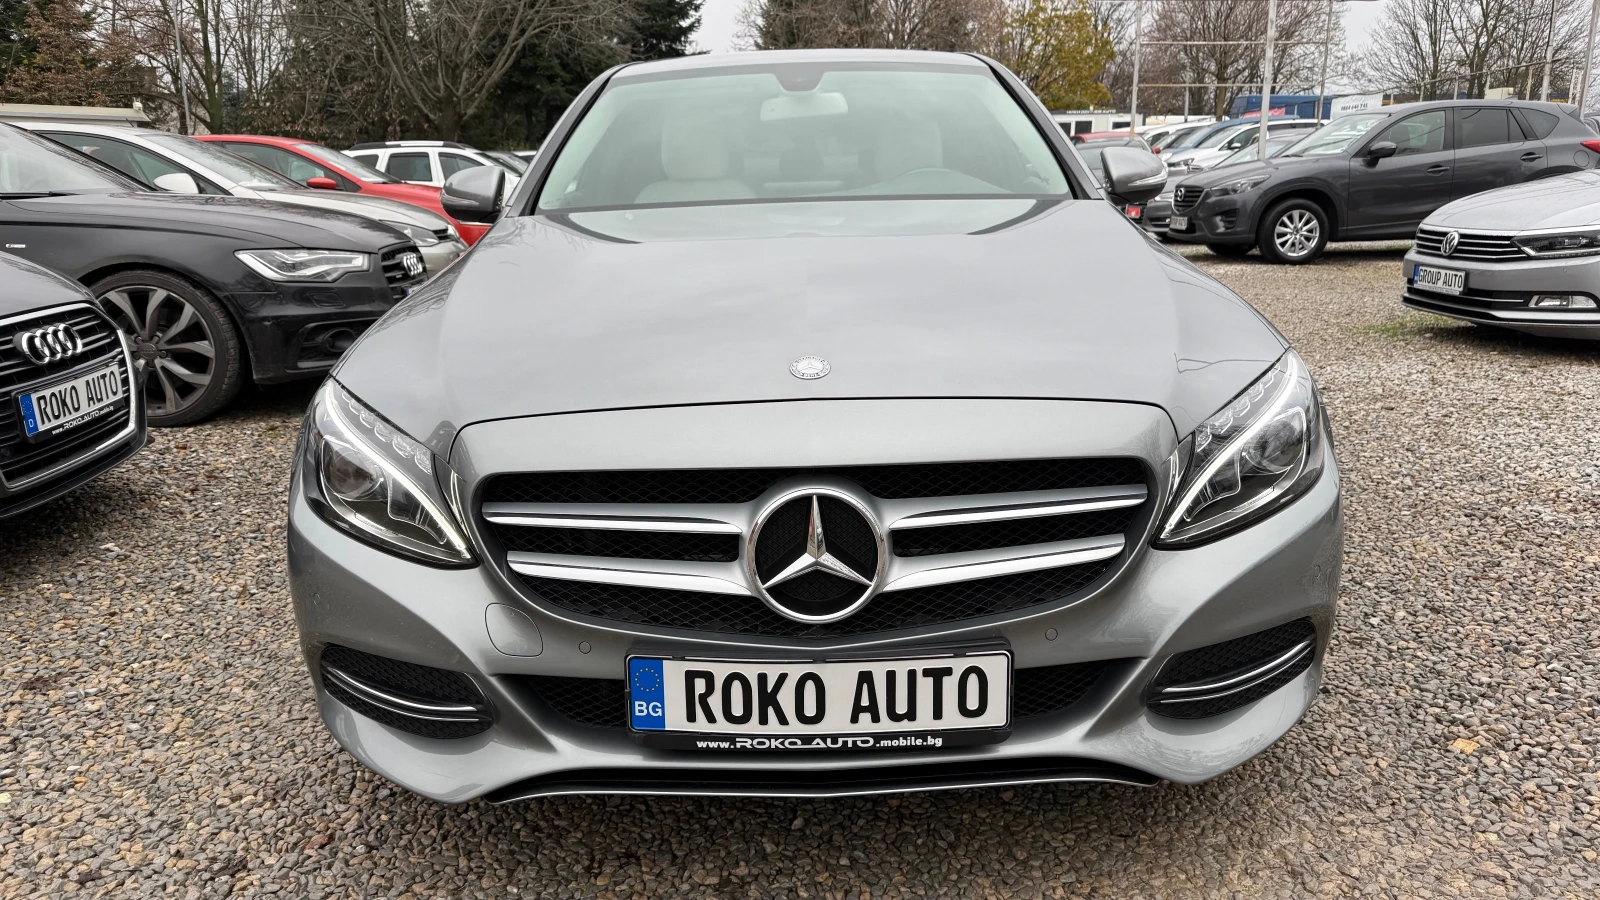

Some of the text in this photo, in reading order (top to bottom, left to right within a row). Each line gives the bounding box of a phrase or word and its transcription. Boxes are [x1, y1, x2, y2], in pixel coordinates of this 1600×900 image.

[1419, 269, 1463, 289] GROUP AUTO
[36, 370, 119, 425] ROKO AUTO
[635, 701, 663, 717] BG
[684, 665, 989, 726] ROKO AUTO
